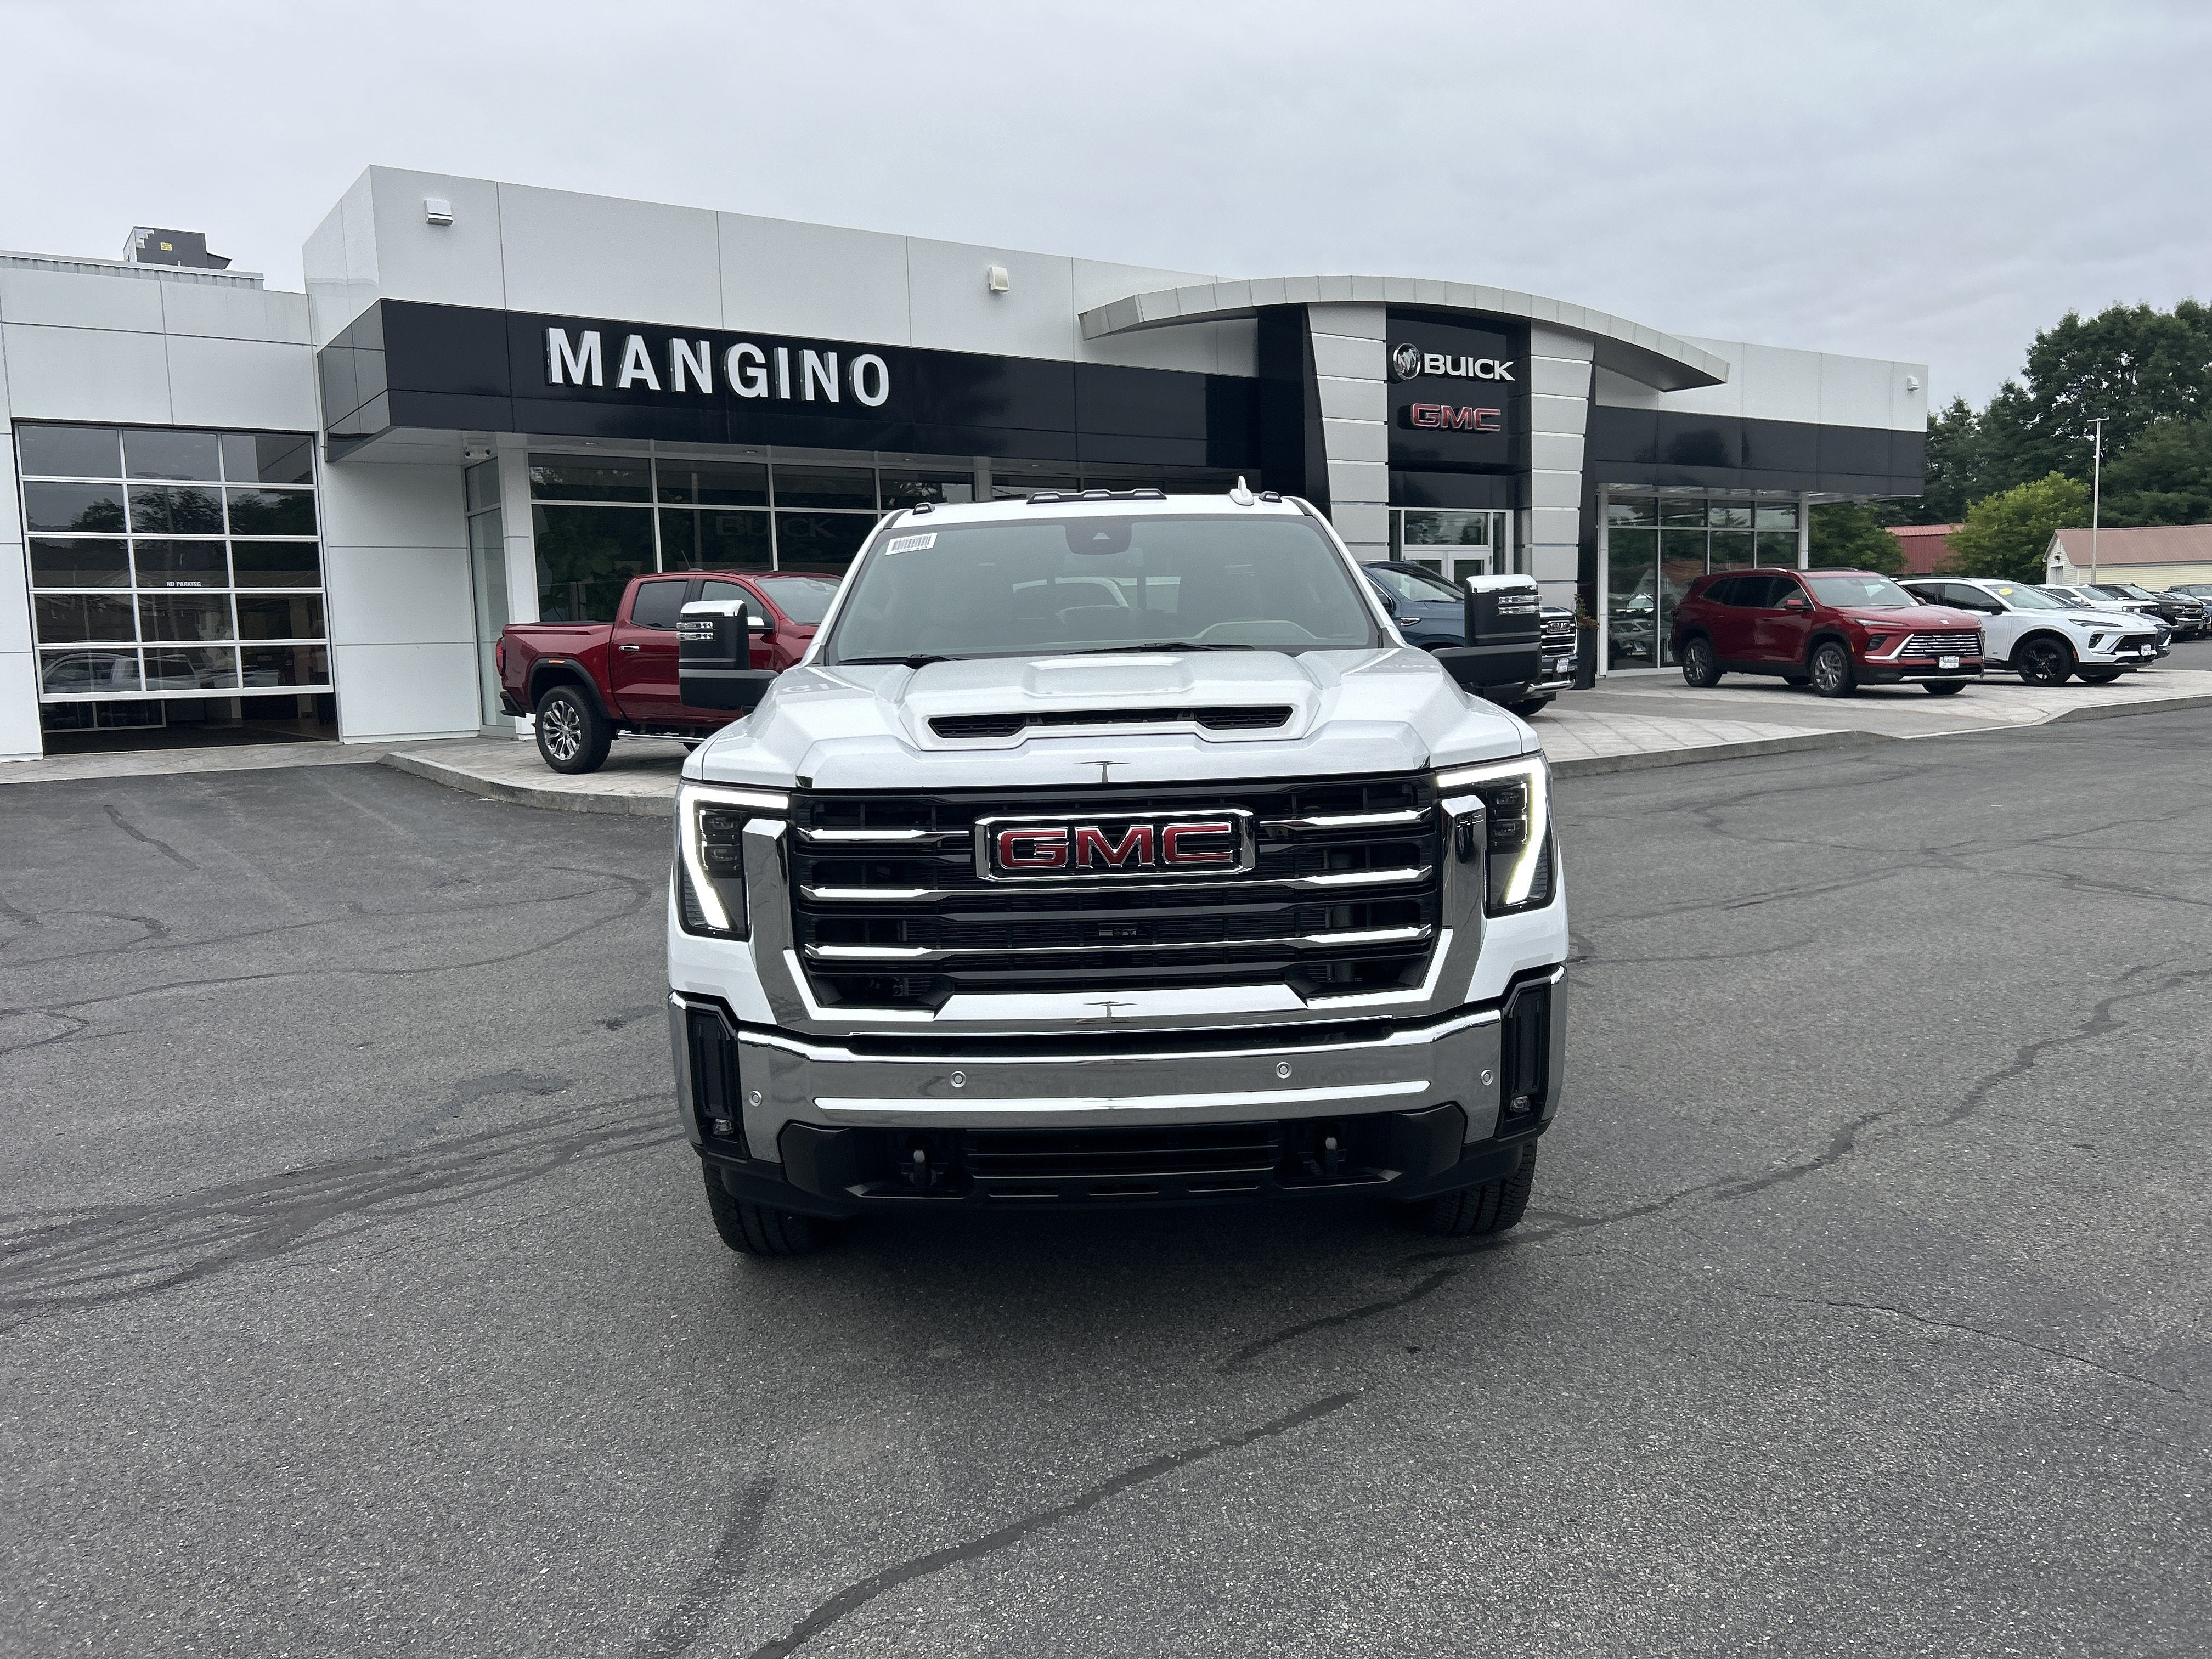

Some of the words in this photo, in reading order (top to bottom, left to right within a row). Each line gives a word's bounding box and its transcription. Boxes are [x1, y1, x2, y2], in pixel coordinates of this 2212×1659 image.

[548, 328, 889, 407] MANGINO
[1424, 353, 1515, 381] BUICK
[1412, 403, 1502, 432] GMC
[997, 821, 1233, 870] GMC
